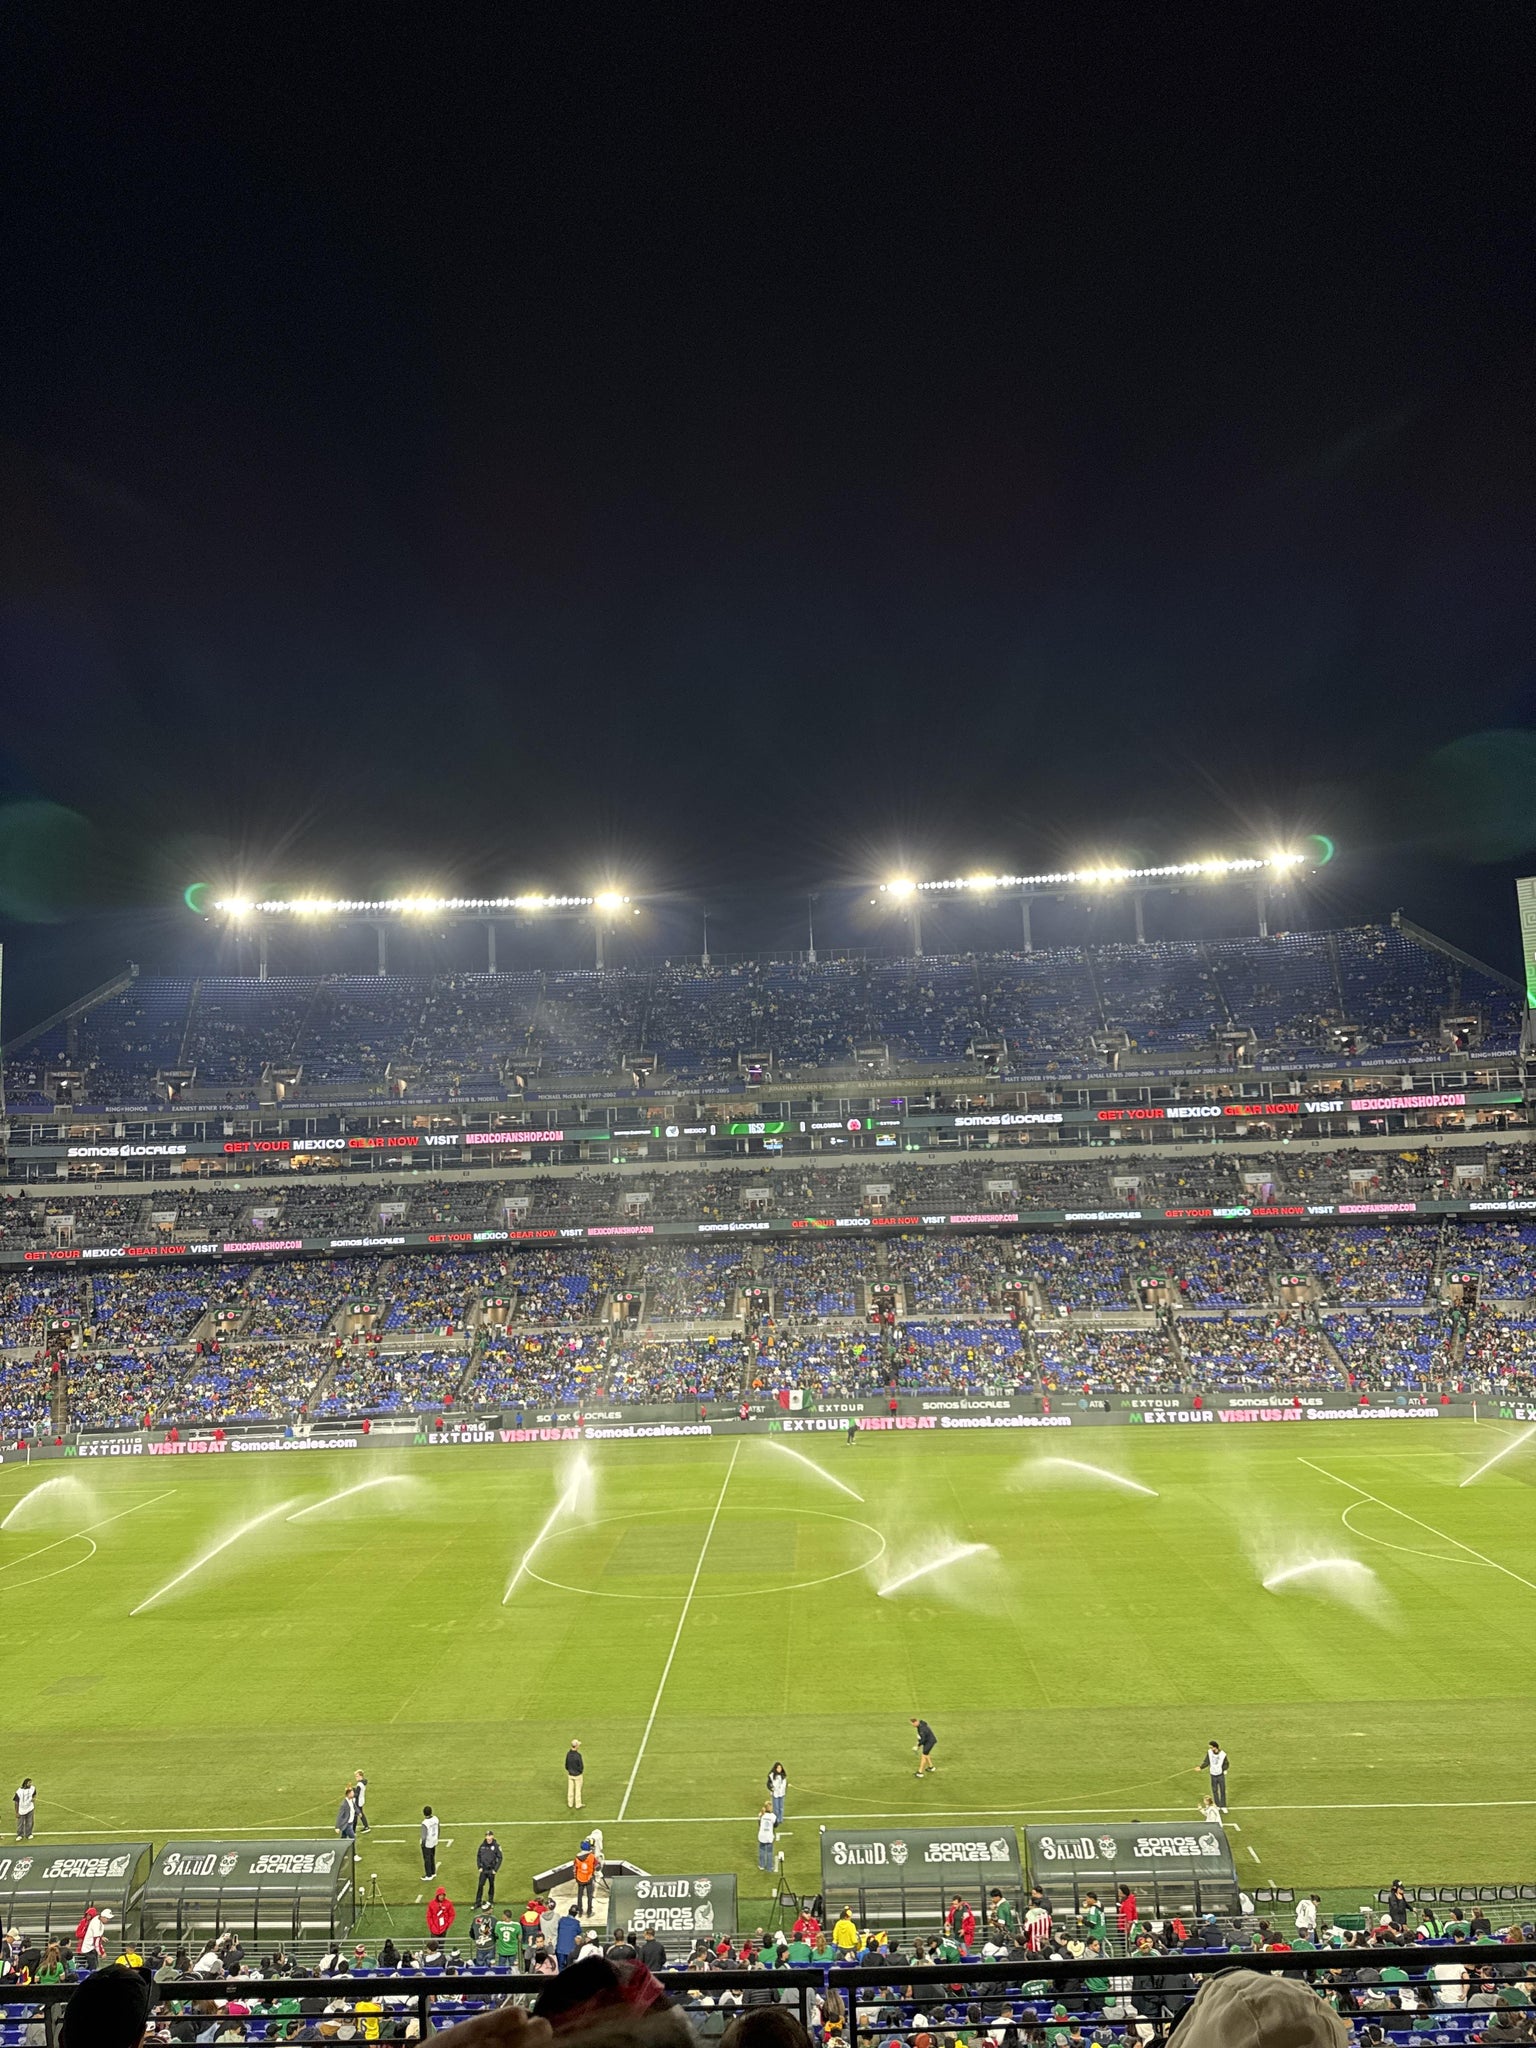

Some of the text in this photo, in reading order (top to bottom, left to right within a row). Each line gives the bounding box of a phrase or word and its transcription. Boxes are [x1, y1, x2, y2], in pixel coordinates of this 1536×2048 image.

[1098, 1094, 1466, 1121] GET YOUR MEXICO GEAR NOW VISIT MEXICOFANSHOP.COM
[954, 1114, 1063, 1126] SOMOS LOCALES
[224, 1130, 564, 1152] GET YOUR MEXICO GEAR NOW VISIT MEXICOFANSHOP.COM
[68, 1145, 187, 1157] SOMOS LOCALES
[1165, 1202, 1416, 1218] GET YOUR MEXICO GEAR NOW VISIT MEXICOFANSHOP.COM
[1470, 1202, 1507, 1210] SOMOS
[1065, 1211, 1142, 1220] SOMOS LOCALES
[698, 1222, 770, 1232] SOMOS LOCALES
[792, 1220, 811, 1228] GET
[812, 1219, 836, 1228] YOUR
[836, 1218, 871, 1227] MEXICO
[872, 1217, 896, 1226] GEAR
[898, 1216, 919, 1225] NOW
[922, 1216, 946, 1224] VISIT
[428, 1234, 447, 1242] GET
[448, 1233, 472, 1242] YOUR
[474, 1231, 509, 1241] MEXICO
[510, 1231, 533, 1240] GEAR
[535, 1230, 558, 1238] NOW
[560, 1228, 584, 1238] VISIT
[330, 1237, 404, 1247] SOMOS LOCALES
[24, 1240, 302, 1260] GET YOUR MEXICO GEAR NOW VISIT MEXICOFANSHOP.COM
[922, 1400, 1010, 1410] SOMOS LOCALES
[1090, 1400, 1107, 1408] AT&
[1121, 1400, 1180, 1408] MEXTOUR
[1229, 1398, 1269, 1406] SOMOS
[808, 1404, 864, 1412] MEXTOUR
[1129, 1406, 1438, 1424] MEXTOUR VISIT US AT SomosLocales.com
[768, 1414, 1071, 1431] MEXTOUR VISIT US AT SomosLocales.com
[414, 1424, 712, 1444] MEXTOUR VISIT US AT SomosLocales.com
[64, 1438, 357, 1456] MEXTOUR VISIT US AT SomosLocales.com
[929, 1842, 988, 1852] SOMOS
[1137, 1837, 1196, 1847] SOMOS
[924, 1852, 991, 1862] LOCALES
[1134, 1846, 1201, 1857] LOCALES
[51, 1858, 110, 1868] SOMOS
[257, 1855, 316, 1864] SOMOS
[42, 1867, 108, 1878] LOCALES
[249, 1863, 315, 1874] LOCALES
[633, 1907, 692, 1920] SOMOS
[628, 1918, 694, 1932] LOCALES
[502, 1931, 510, 1942] 9
